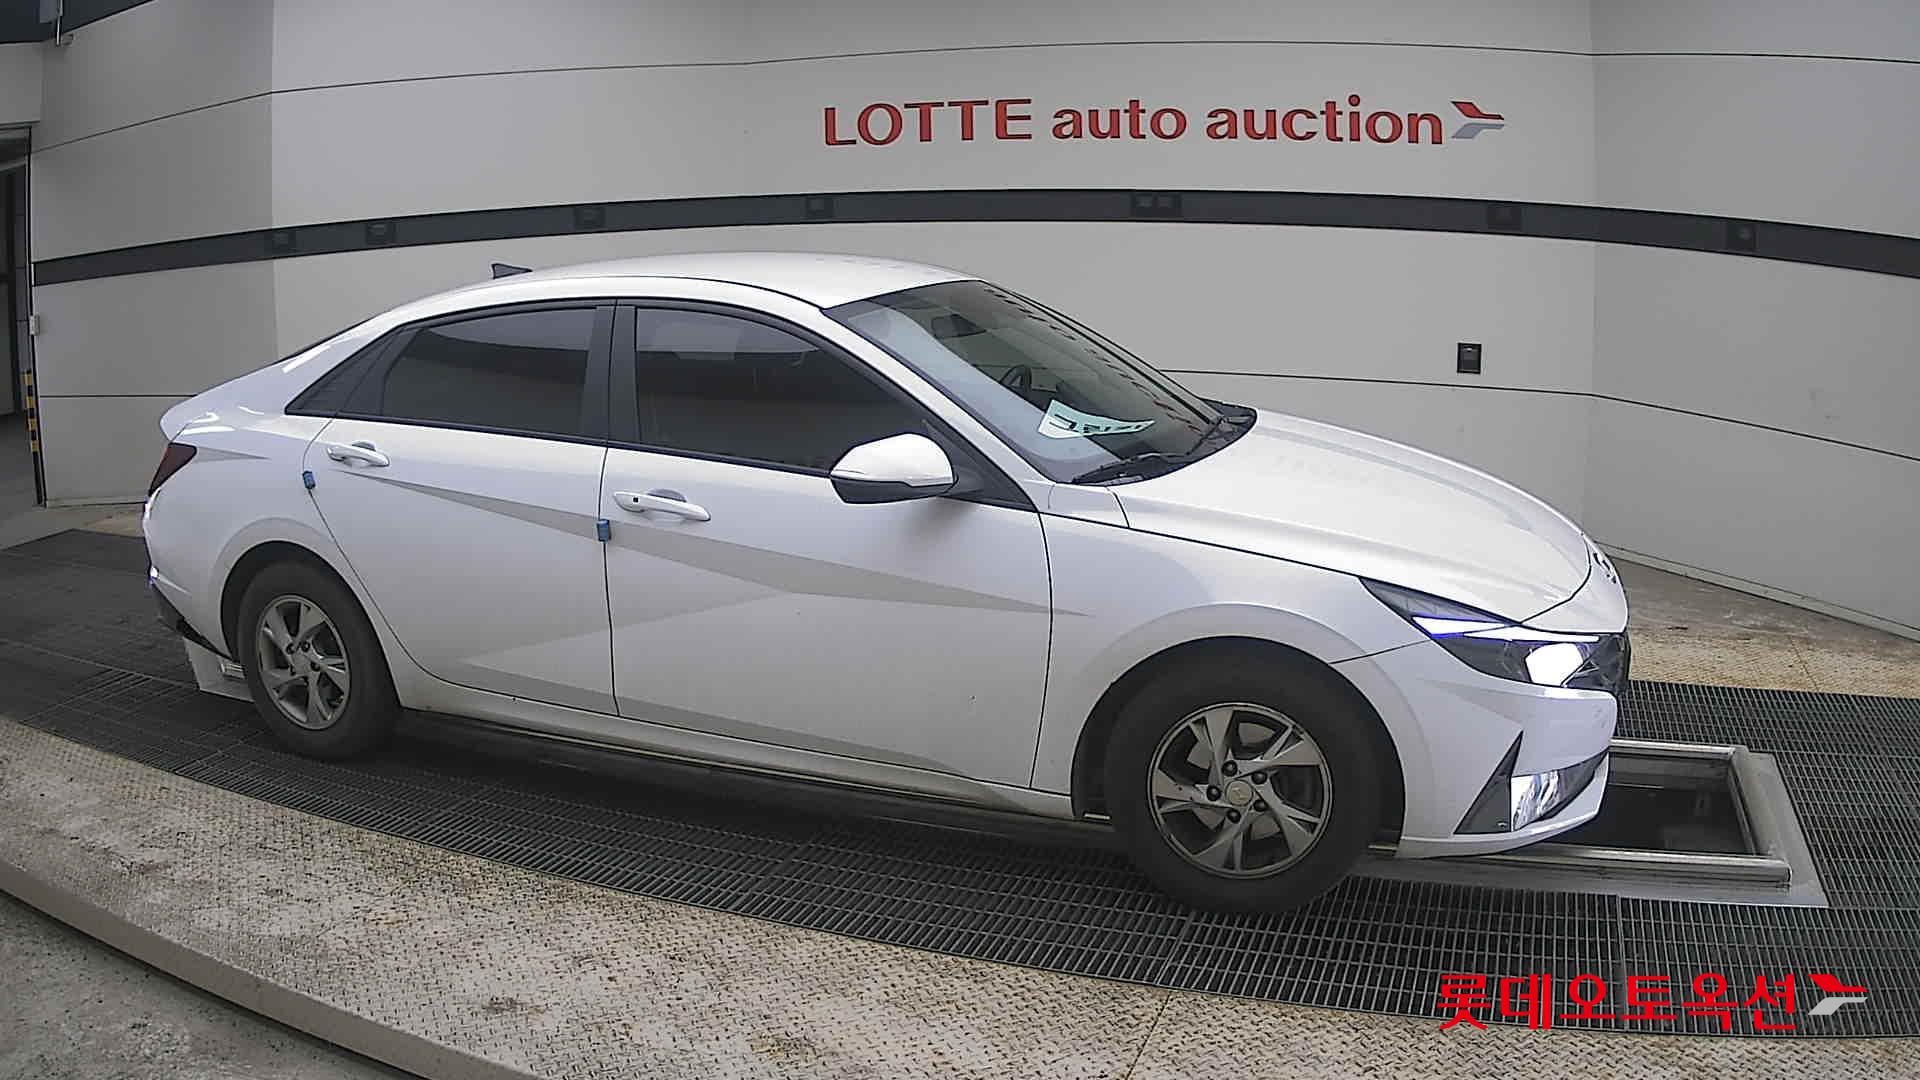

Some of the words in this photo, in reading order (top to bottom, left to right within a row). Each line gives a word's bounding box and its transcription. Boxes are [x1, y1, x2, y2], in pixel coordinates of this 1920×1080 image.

[825, 99, 1032, 146] LOTTE
[1053, 99, 1188, 140] auto
[1206, 95, 1443, 144] auction
